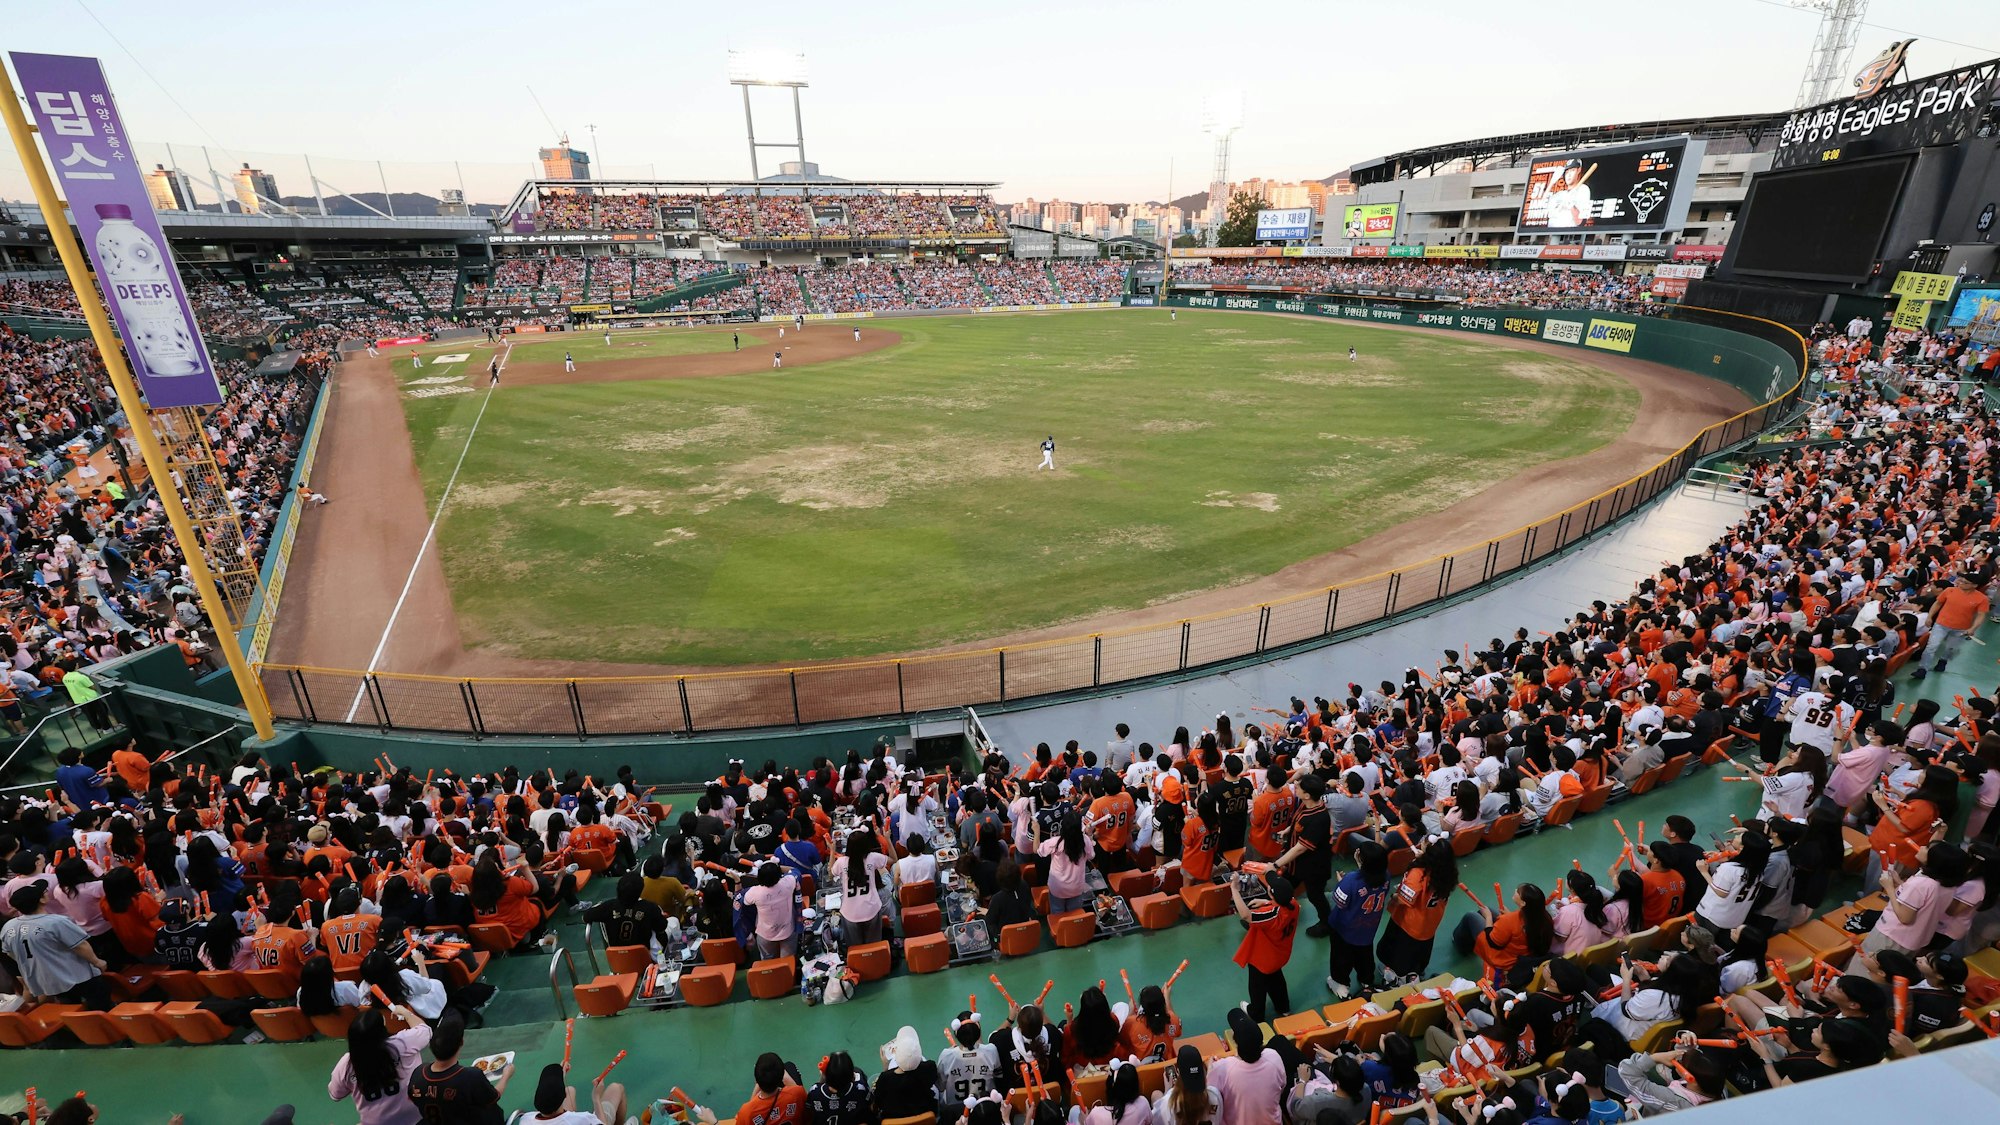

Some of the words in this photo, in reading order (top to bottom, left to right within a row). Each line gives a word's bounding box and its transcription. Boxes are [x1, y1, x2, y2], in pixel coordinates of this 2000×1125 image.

[1780, 109, 1840, 147] 한화생명
[1839, 99, 1914, 135] Eagles
[1915, 77, 1985, 118] Park
[35, 91, 115, 180] 딥스
[90, 94, 125, 161] 해양심층수
[1261, 213, 1279, 225] 수술
[1287, 212, 1306, 223] 재활
[1380, 207, 1392, 215] 달인
[1978, 212, 1992, 229] 99
[1271, 229, 1305, 237] 대전웰니스병원
[1314, 247, 1347, 255] 당진9988병원
[116, 283, 172, 300] DEEPS
[1226, 299, 1258, 308] 한남대학교
[1422, 314, 1453, 325] 예가정성
[1460, 316, 1497, 331] 영신타올
[1504, 318, 1540, 335] 대방건설
[1552, 323, 1582, 340] 음성명작
[1589, 324, 1634, 344] ABC타이어
[1813, 605, 1827, 617] 99
[1804, 708, 1833, 728] 99
[1106, 811, 1127, 829] 99
[1272, 808, 1290, 827] 99
[1361, 892, 1385, 915] 41
[22, 939, 33, 958] 1
[335, 932, 361, 955] V1
[165, 947, 194, 962] 99
[952, 1064, 988, 1077] 박지환
[954, 1079, 986, 1100] 93
